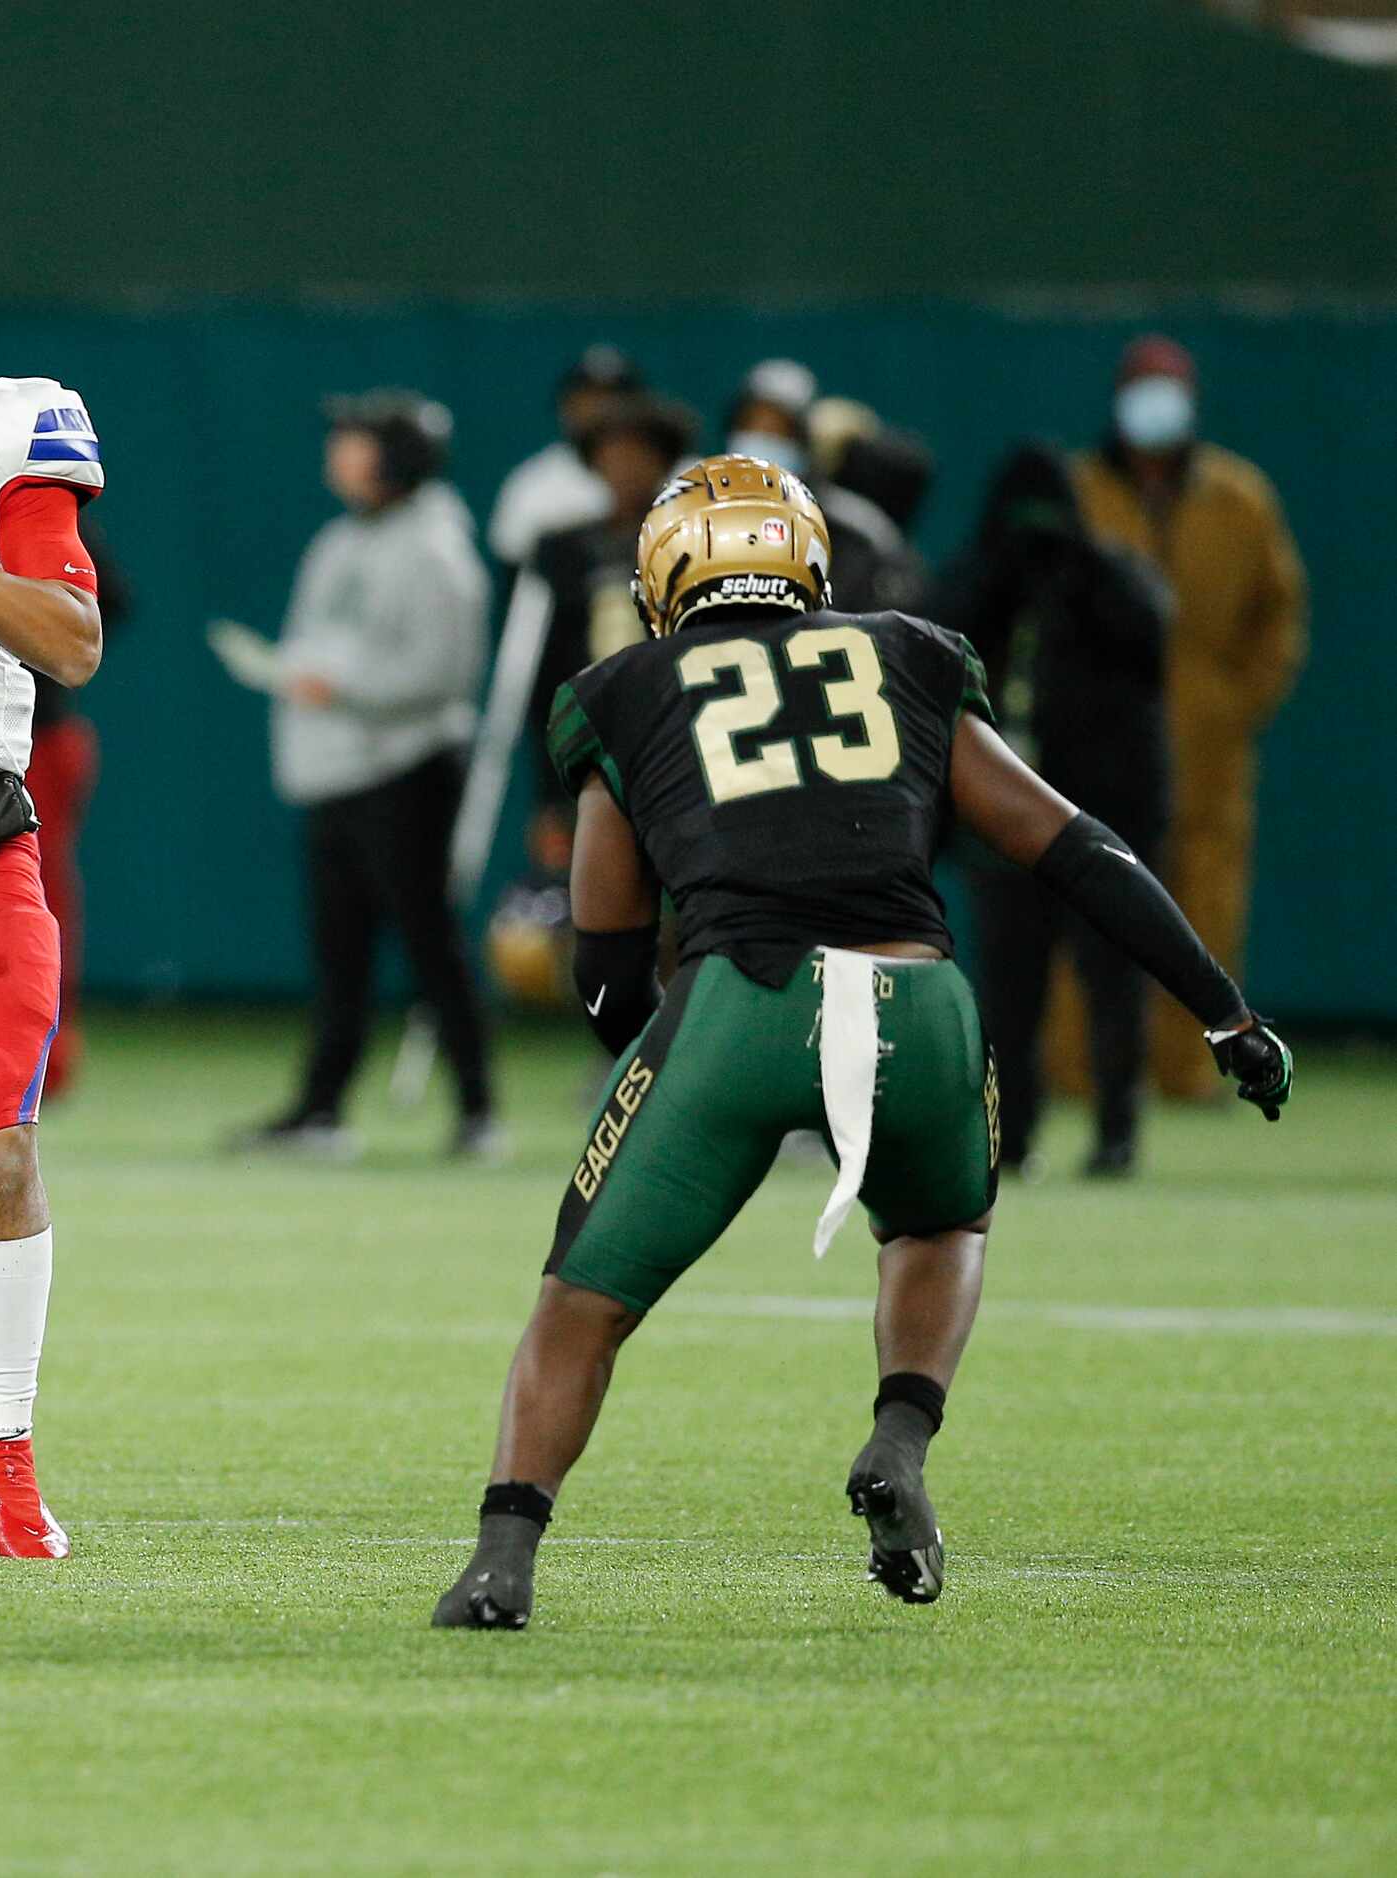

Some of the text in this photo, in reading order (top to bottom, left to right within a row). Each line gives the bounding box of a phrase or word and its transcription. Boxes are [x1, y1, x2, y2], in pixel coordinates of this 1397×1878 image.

[720, 573, 788, 594] schutt
[675, 625, 901, 804] 23
[574, 1057, 653, 1202] EAGLES
